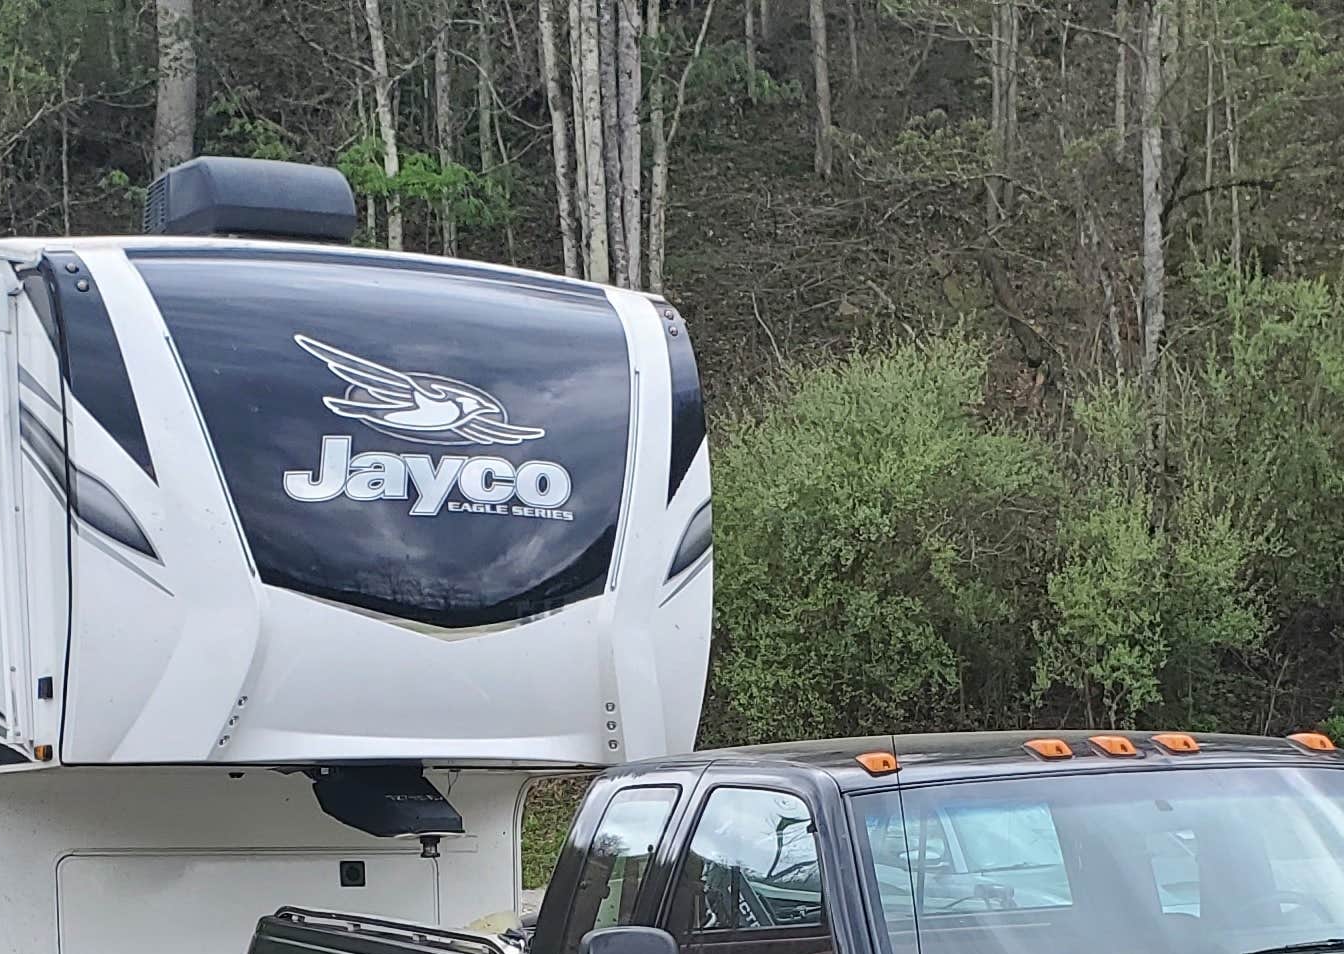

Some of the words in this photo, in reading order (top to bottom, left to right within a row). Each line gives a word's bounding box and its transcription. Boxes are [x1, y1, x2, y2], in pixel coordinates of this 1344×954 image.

[283, 435, 573, 516] Jayco
[447, 501, 509, 515] EAGLE
[511, 505, 574, 521] SERIES
